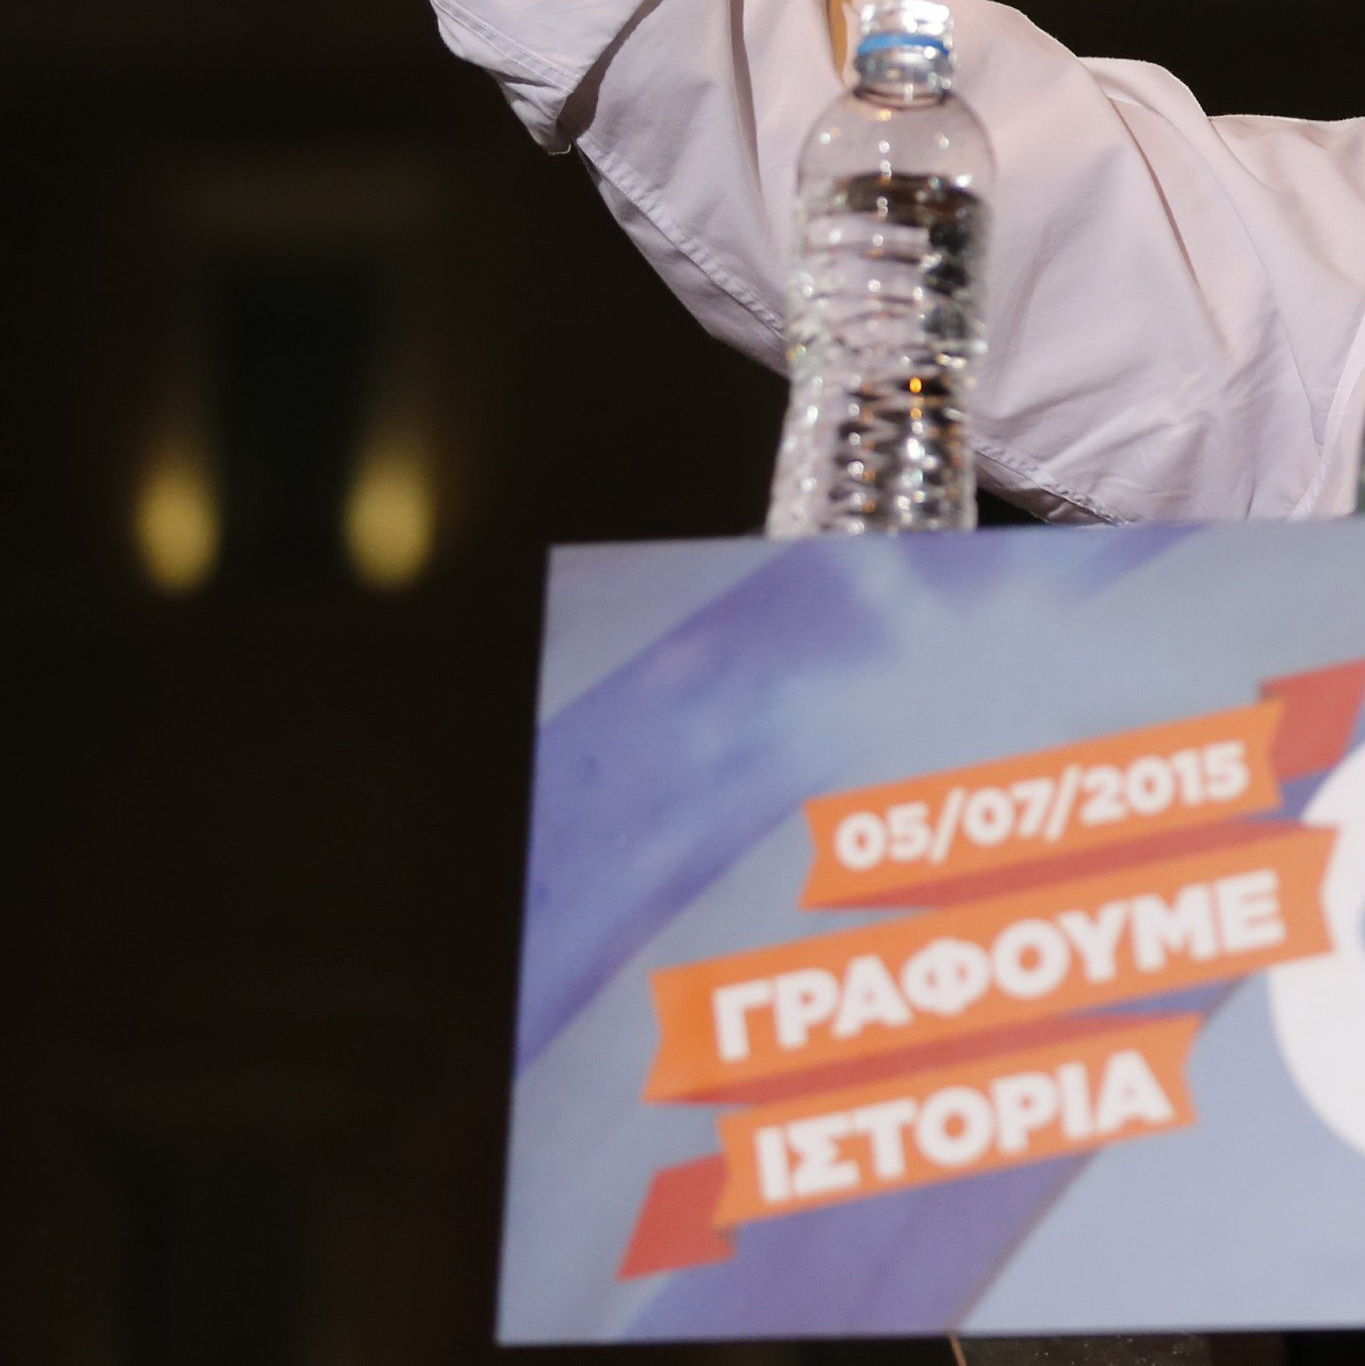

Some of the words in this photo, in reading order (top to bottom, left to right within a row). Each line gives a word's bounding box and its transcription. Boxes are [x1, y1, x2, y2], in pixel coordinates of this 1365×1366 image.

[834, 739, 1251, 872] 05/07/2015
[711, 867, 1287, 1063] ΓΡΑΦΟΥΜΕ
[753, 1048, 1175, 1205] ΙΣΤΟΡΙΑ
